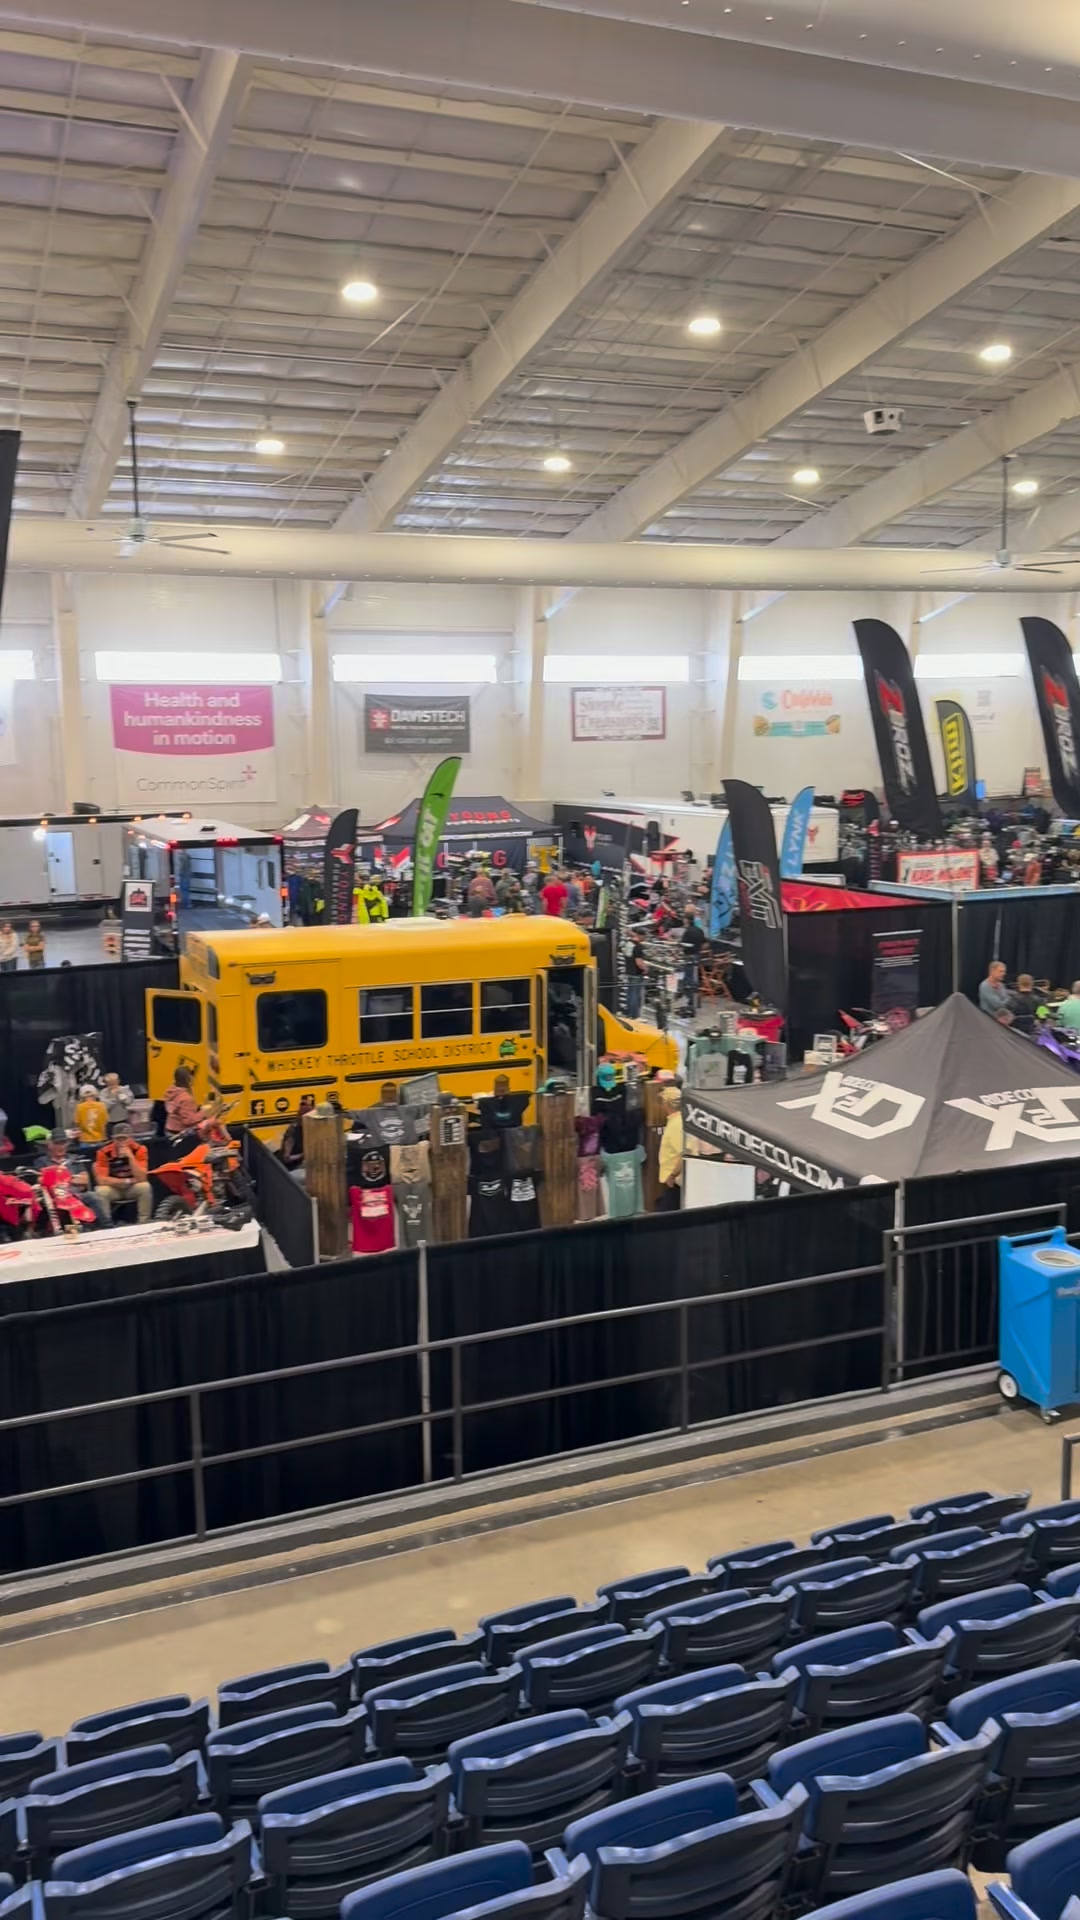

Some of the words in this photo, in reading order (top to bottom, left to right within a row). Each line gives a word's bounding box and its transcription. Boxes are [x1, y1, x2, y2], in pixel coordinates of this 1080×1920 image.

[144, 692, 203, 708] Health
[207, 692, 241, 708] and
[123, 711, 263, 727] humankindness
[153, 730, 170, 745] in
[173, 730, 236, 745] motion
[267, 1055, 321, 1072] WHISKEY
[327, 1050, 385, 1067] THROTTLE
[393, 1045, 438, 1062] SCHOOL
[443, 1041, 492, 1058] DISTRICT
